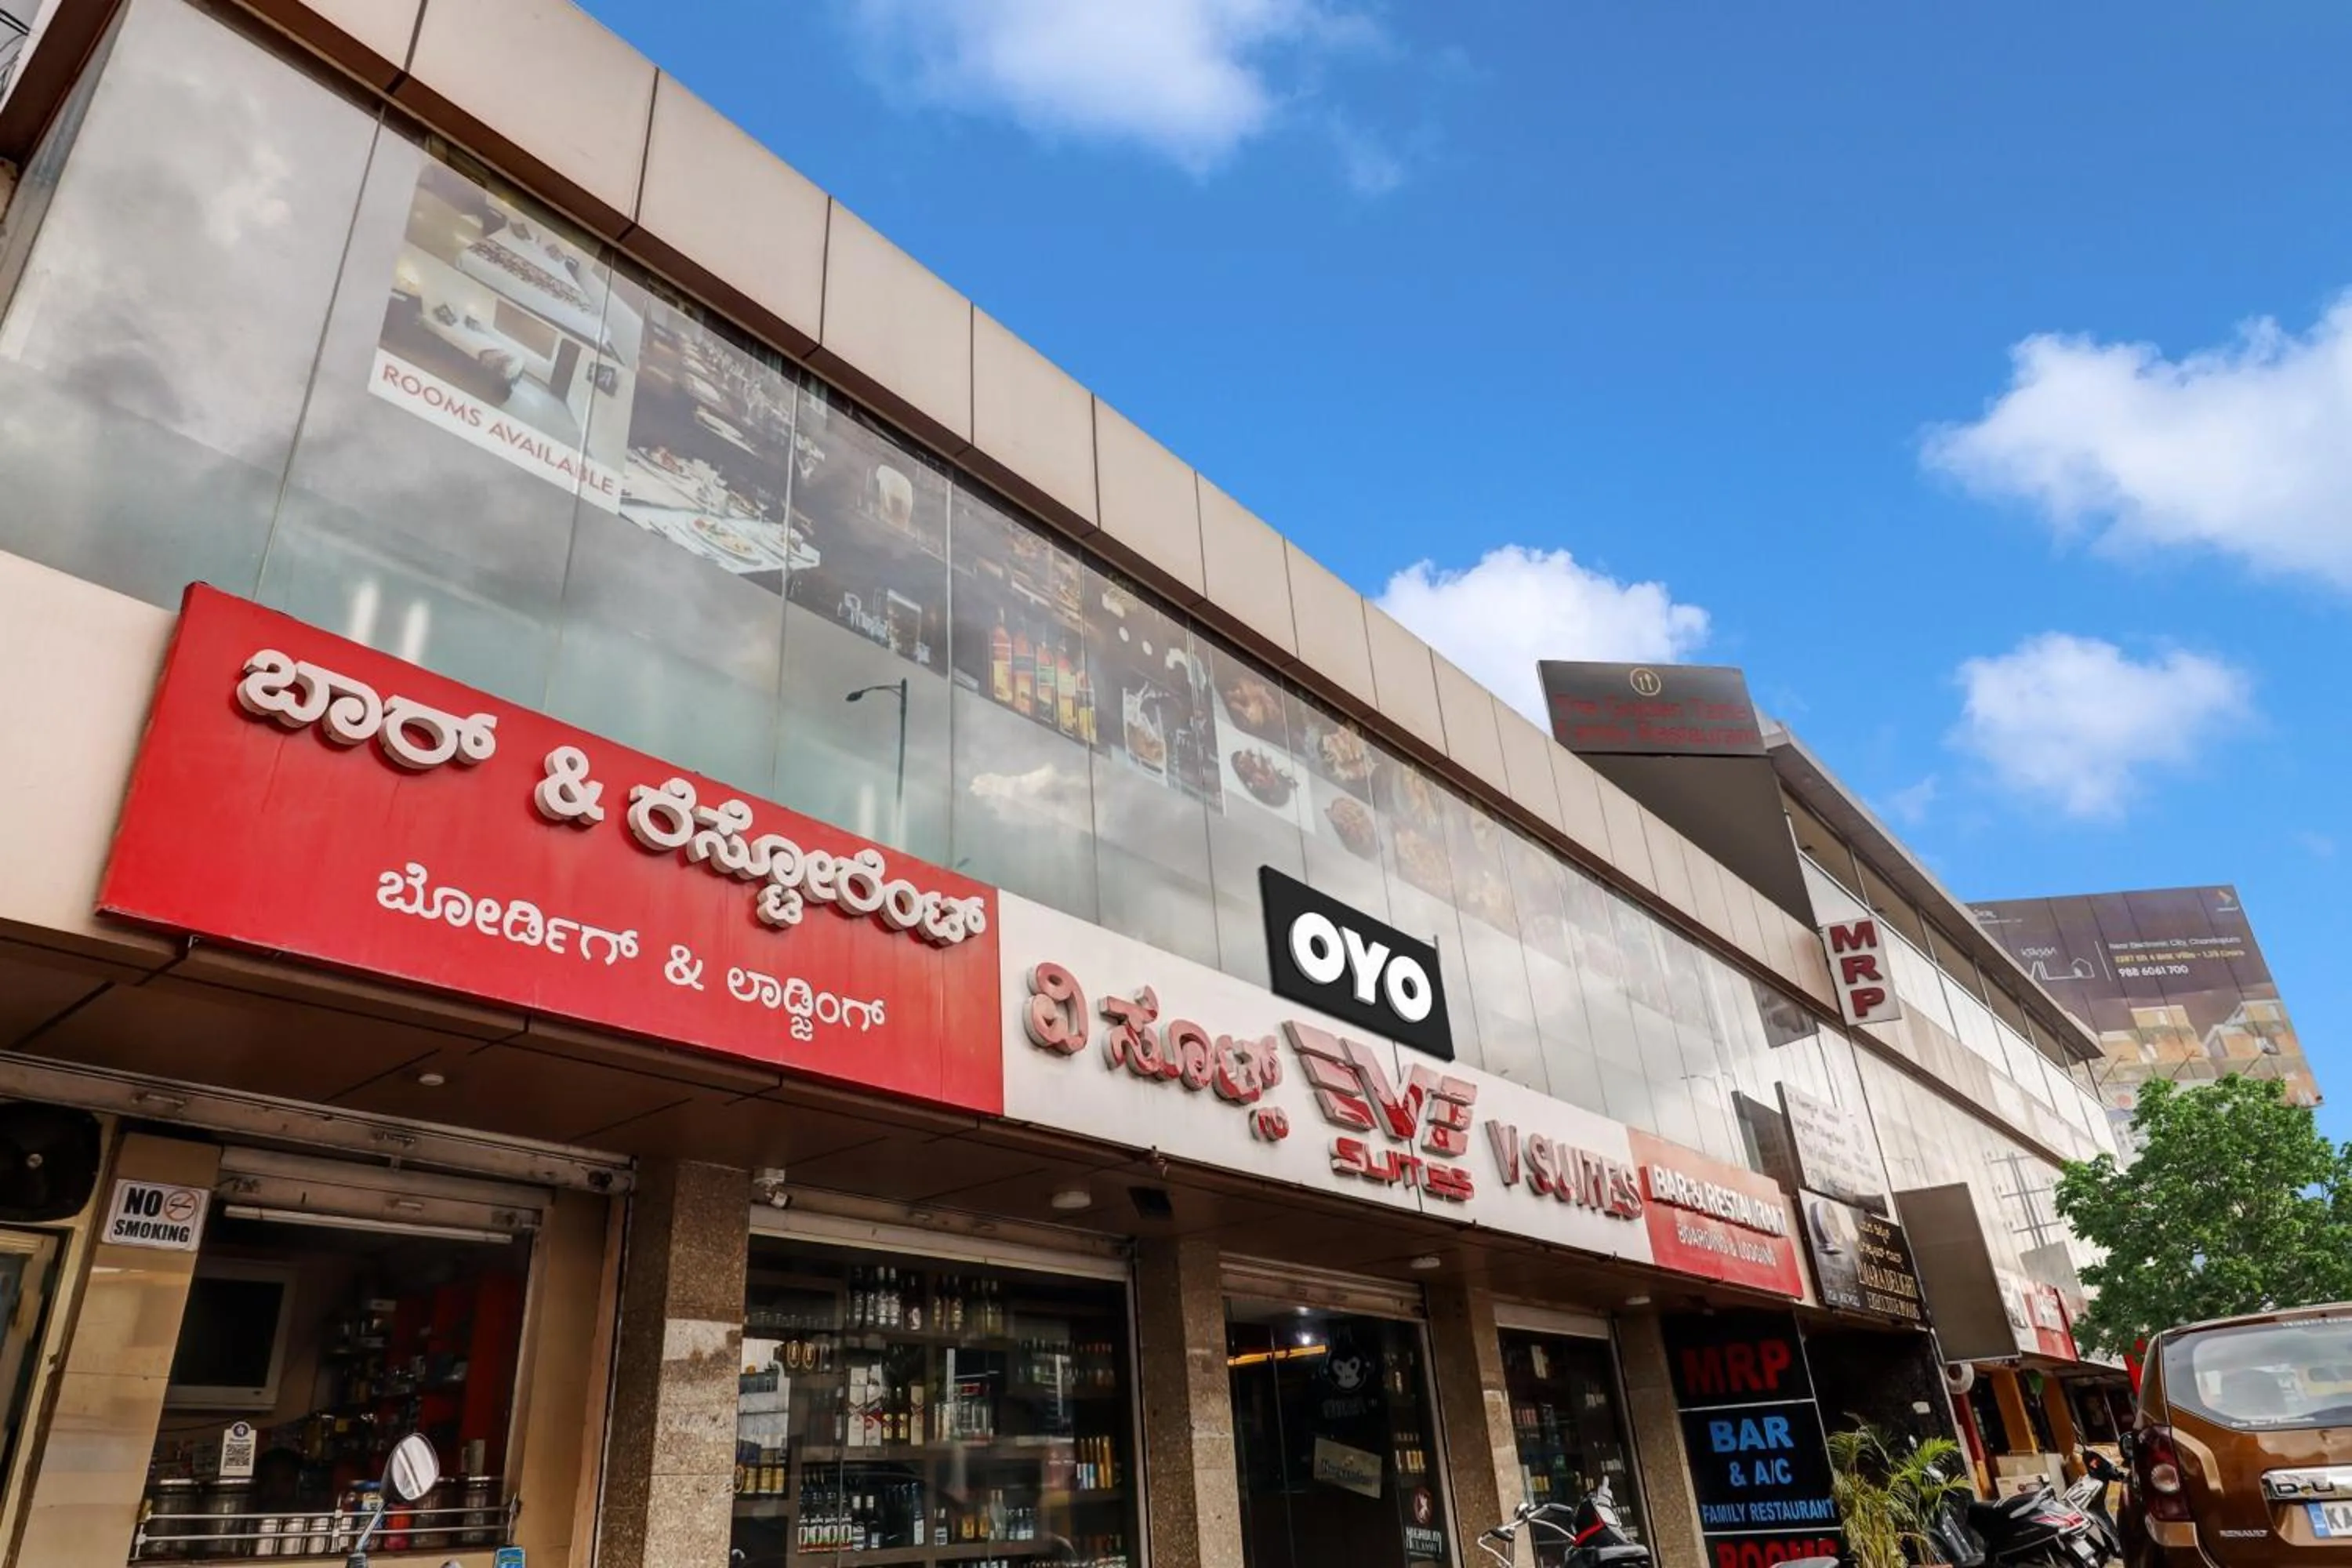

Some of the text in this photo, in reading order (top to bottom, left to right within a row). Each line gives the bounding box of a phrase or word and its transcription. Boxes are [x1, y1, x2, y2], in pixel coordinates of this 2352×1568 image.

[383, 364, 614, 496] ROOMS AVAILABLE
[235, 648, 497, 770] ಬಾರ್
[534, 745, 604, 826] &
[664, 944, 704, 992] &
[1289, 912, 1433, 1022] OYO
[1828, 920, 1886, 1018] MRP
[1329, 1136, 1475, 1201] SUITES
[1522, 1132, 1642, 1220] SUITES
[123, 1186, 164, 1217] NO
[114, 1219, 191, 1243] SMOKING
[1680, 1338, 1791, 1395] MRP
[1708, 1415, 1795, 1454] BAR
[1729, 1457, 1793, 1487] & A/C
[1701, 1497, 1836, 1525] FAMILY RESTAURANT
